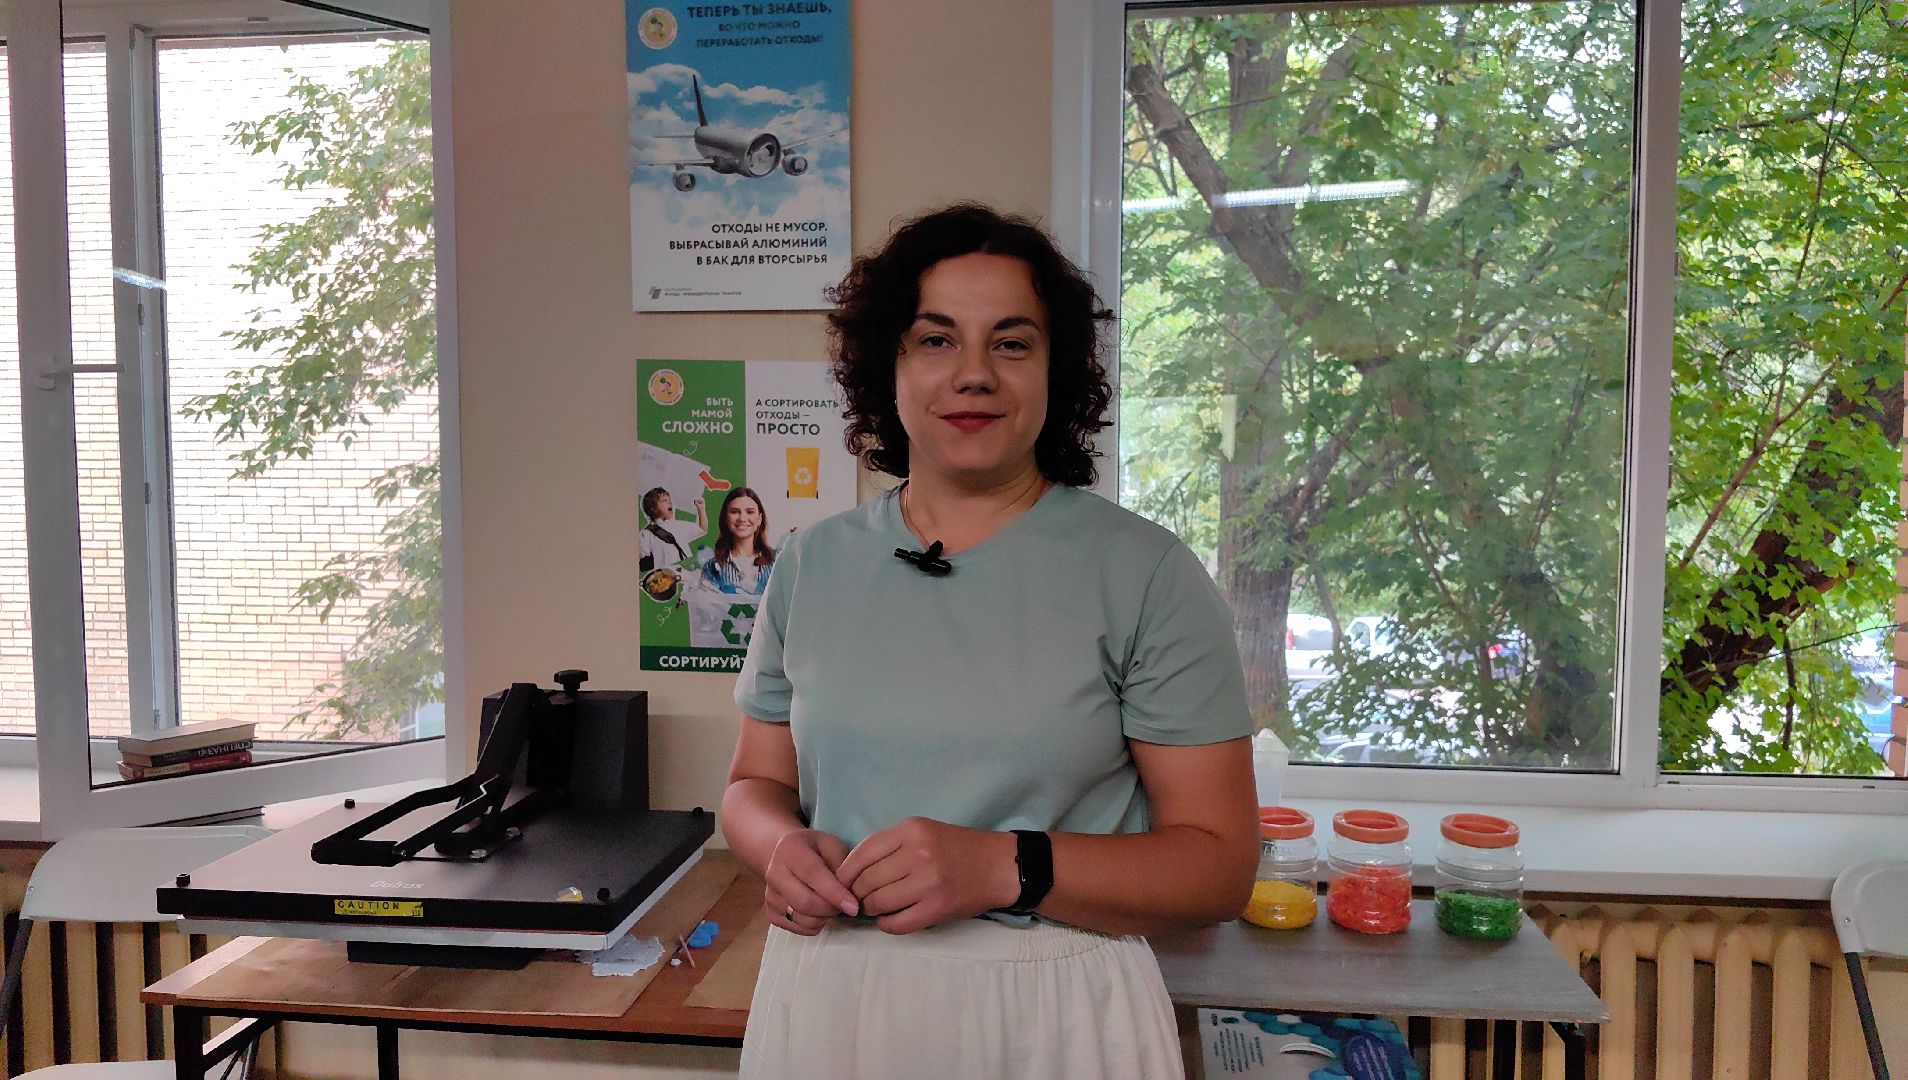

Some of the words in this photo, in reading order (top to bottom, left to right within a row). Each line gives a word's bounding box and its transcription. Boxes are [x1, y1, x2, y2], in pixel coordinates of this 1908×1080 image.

[687, 5, 740, 18] ТЕПЕРЬ
[742, 3, 763, 15] ТЫ
[767, 1, 832, 14] ЗНАЕШЬ,
[718, 23, 733, 32] ВО
[735, 22, 756, 31] ЧТО
[758, 20, 801, 30] МОЖНО
[696, 37, 773, 48] ПЕРЕРАБОТАТЬ
[711, 223, 763, 234] ОТХОДЫ
[765, 222, 780, 232] НЕ
[783, 222, 828, 232] МУСОР.
[669, 237, 749, 250] ВЫБРАСЫВАЙ
[752, 236, 828, 249] АЛЮМИНИЙ
[696, 255, 703, 265] В
[706, 255, 729, 265] БАК
[731, 255, 755, 266] ДЛЯ
[758, 254, 828, 264] ВТОРСЫРЬЯ
[706, 397, 734, 406] БЫТЬ
[755, 399, 763, 407] А
[765, 399, 839, 409] СОРТИРОВАТЬ
[691, 408, 733, 418] МАМОЙ
[755, 411, 800, 420] ОТХОДЫ
[662, 420, 734, 434] СЛОЖНО
[756, 422, 820, 435] ПРОСТО
[337, 900, 399, 910] CAUTION
